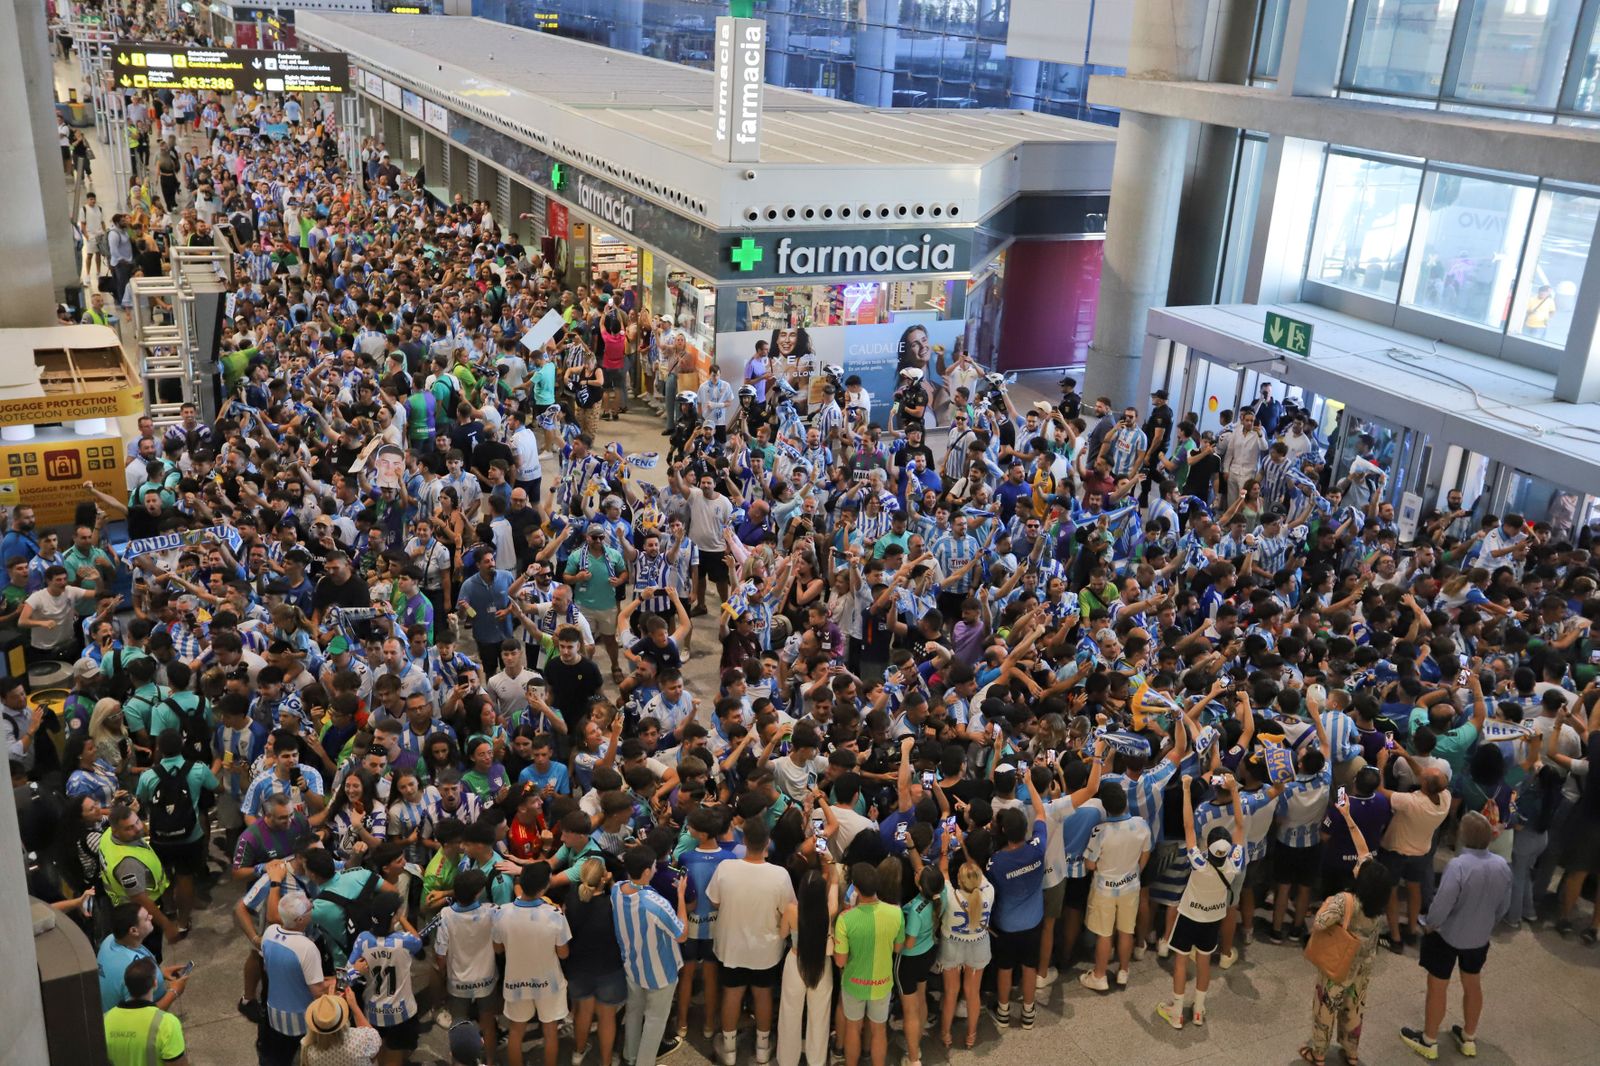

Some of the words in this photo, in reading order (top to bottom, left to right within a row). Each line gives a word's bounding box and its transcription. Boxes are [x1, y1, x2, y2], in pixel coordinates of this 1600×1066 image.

[216, 62, 244, 70] seguridad
[182, 77, 206, 89] 363
[210, 78, 235, 90] 386
[716, 25, 730, 140] farmacia
[737, 27, 762, 144] farmacia
[578, 174, 635, 232] farmacia
[777, 233, 956, 275] farmacia
[46, 396, 117, 409] PROTECTION
[66, 405, 119, 417] EQUIPAJES
[19, 486, 58, 495] LUGGAGE
[131, 533, 180, 554] ONDO
[371, 966, 396, 995] 11
